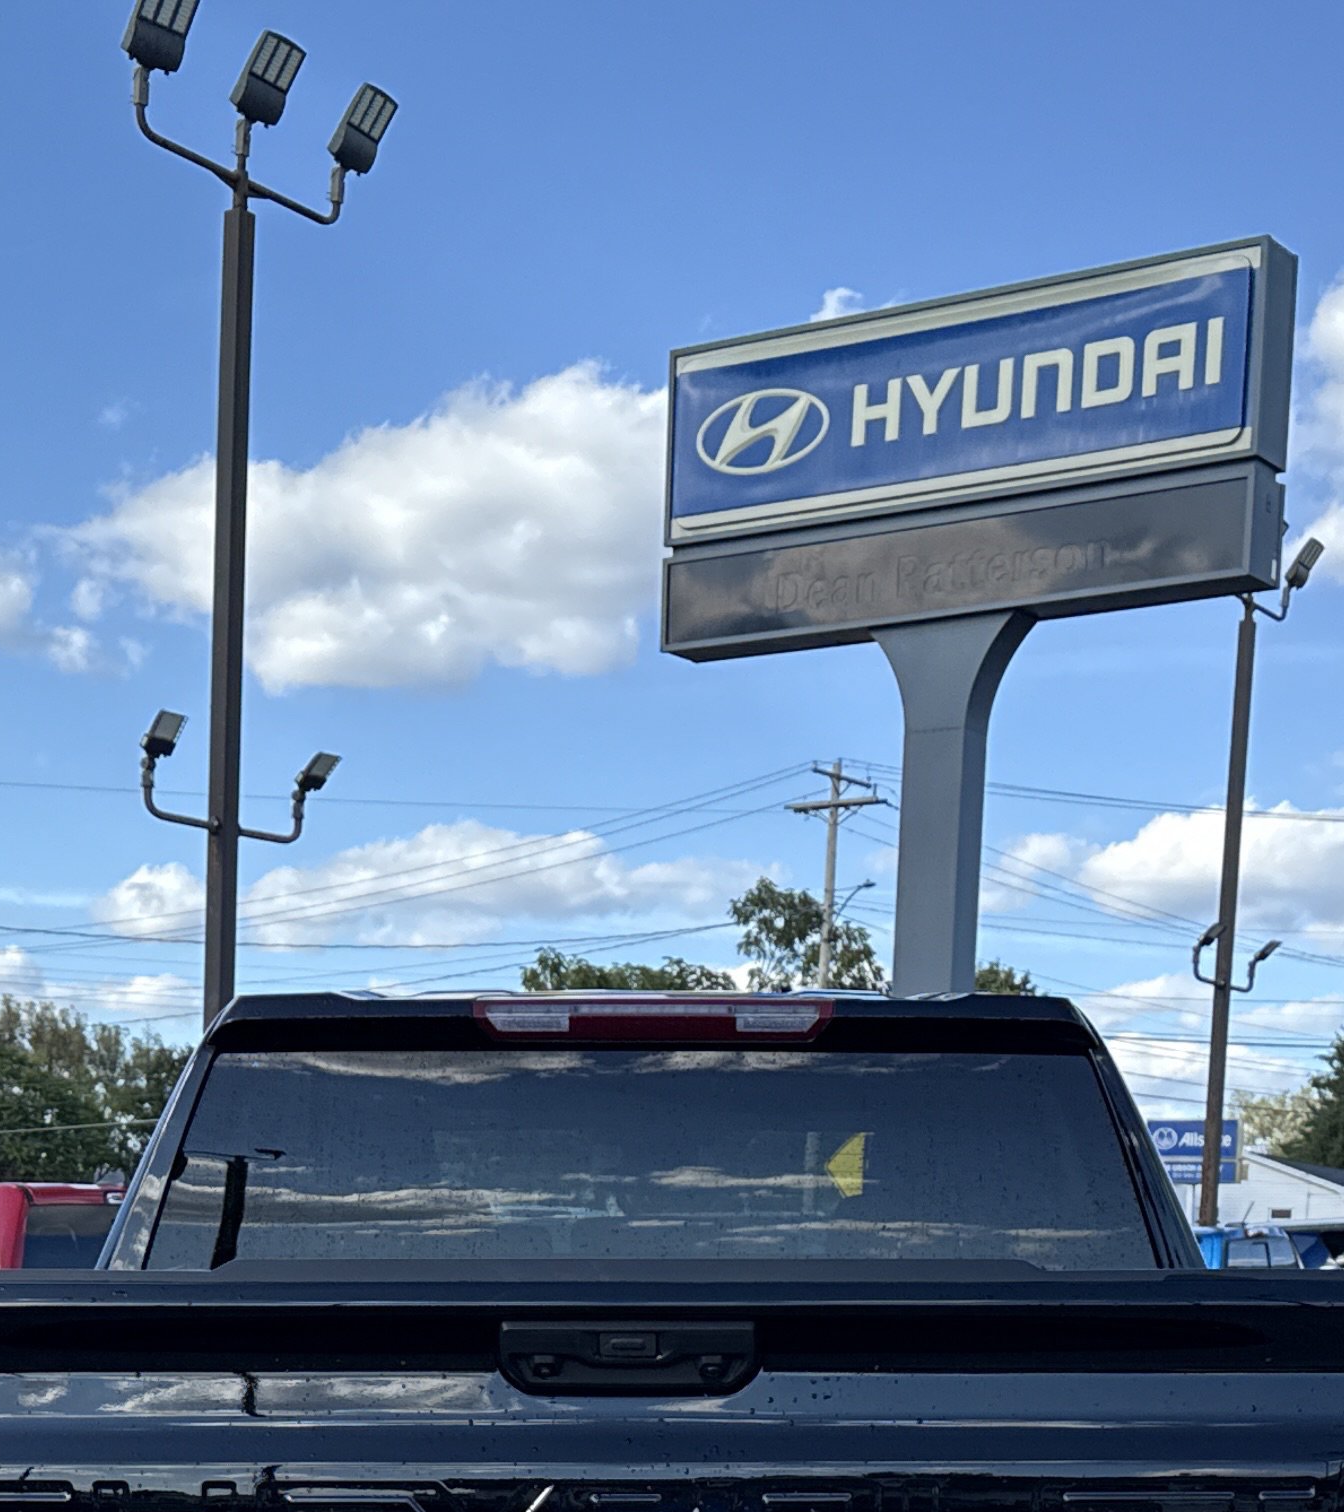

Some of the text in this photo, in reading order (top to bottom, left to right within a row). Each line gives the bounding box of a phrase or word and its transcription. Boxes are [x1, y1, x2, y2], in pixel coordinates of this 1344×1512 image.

[849, 316, 1225, 447] HYUNDAI
[774, 538, 1109, 615] Dean Patterson
